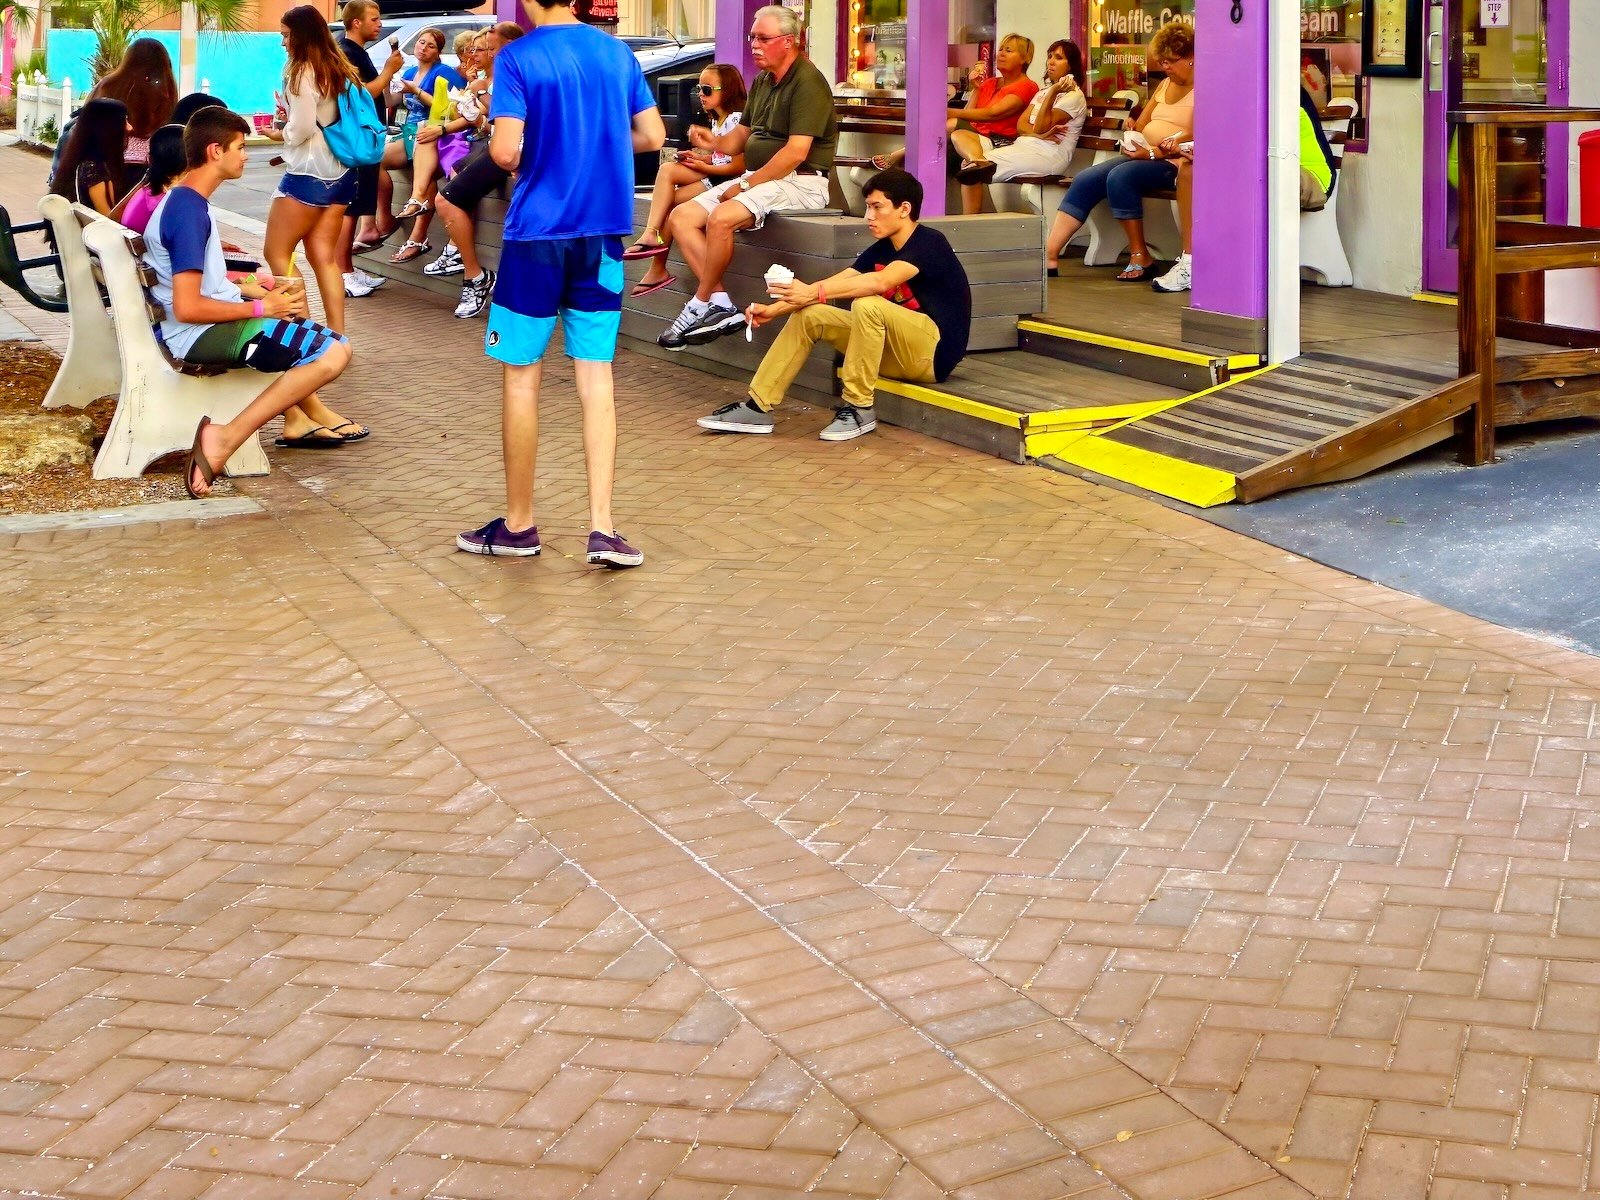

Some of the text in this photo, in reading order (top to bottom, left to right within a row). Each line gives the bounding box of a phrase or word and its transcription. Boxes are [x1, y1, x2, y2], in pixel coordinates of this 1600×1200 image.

[1488, 3, 1502, 11] STEP
[1106, 7, 1196, 34] Waffle Con
[1102, 50, 1145, 65] Smoothies
